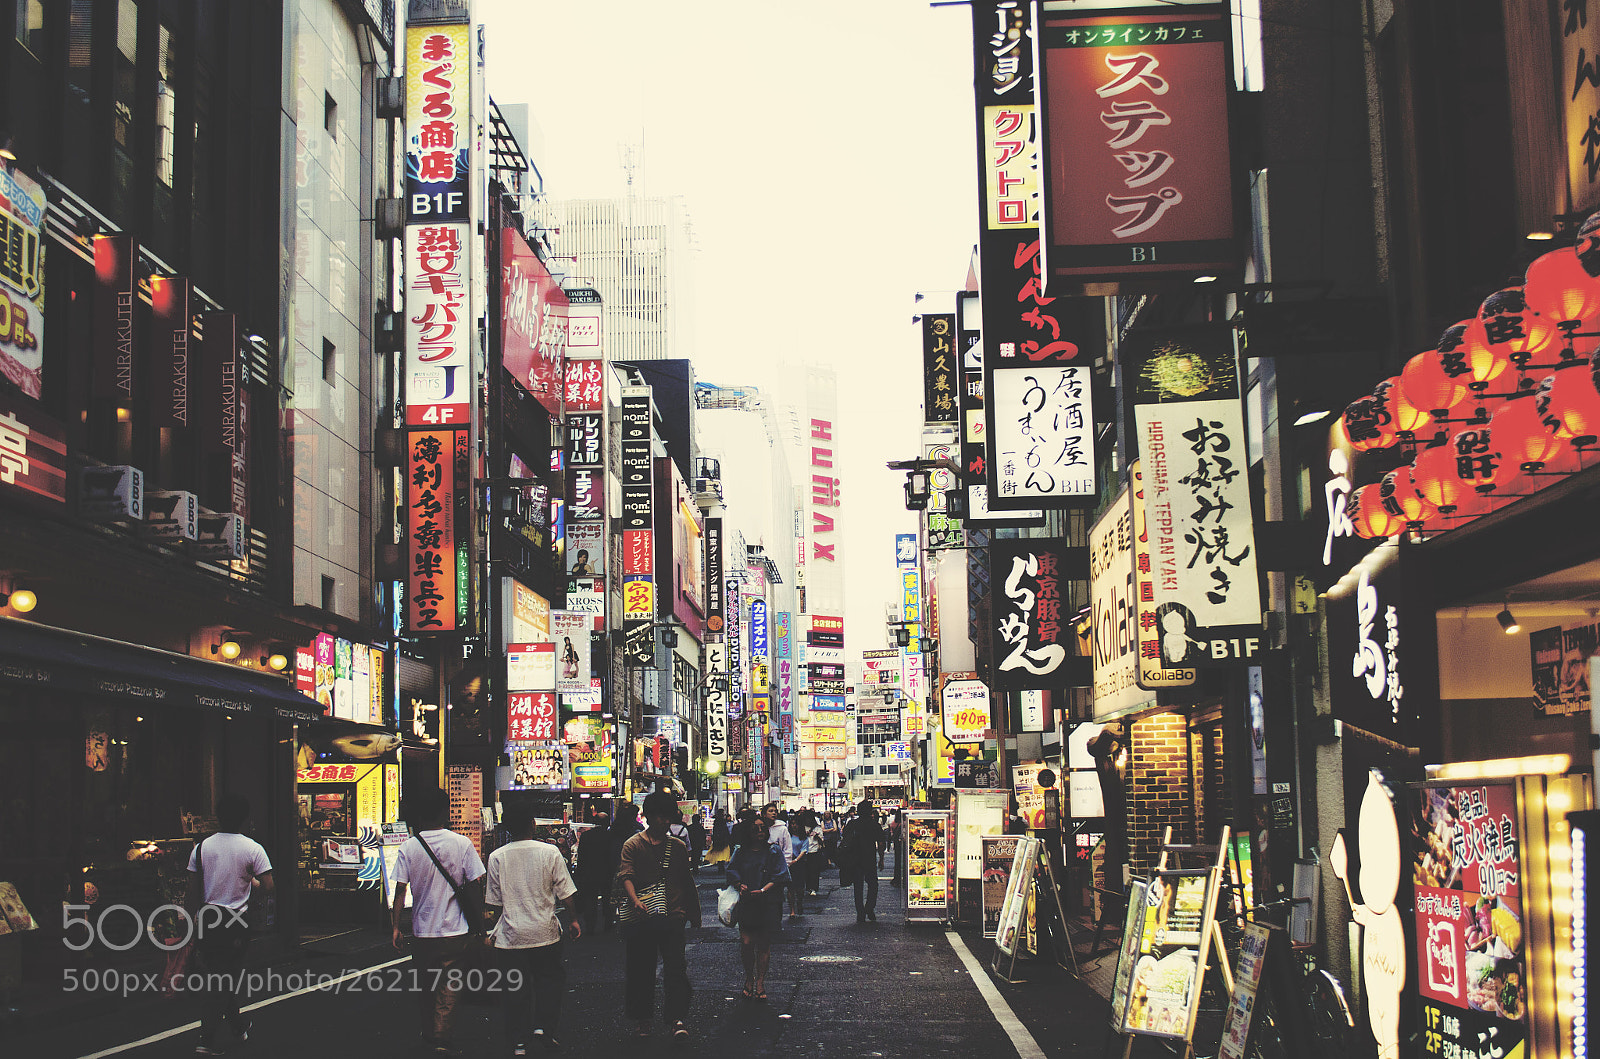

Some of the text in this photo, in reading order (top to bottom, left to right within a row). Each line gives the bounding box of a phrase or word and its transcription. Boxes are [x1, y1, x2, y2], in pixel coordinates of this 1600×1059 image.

[1065, 26, 1205, 45] オンラインカフェ
[420, 34, 456, 183] まぐろ商店
[992, 110, 1027, 225] クアトロ
[1094, 51, 1183, 240] ステップ
[411, 191, 464, 216] B1F
[1130, 245, 1157, 263] B1
[411, 226, 465, 364] 熟女キャバクラ
[116, 291, 132, 391] ANRAKUTEI
[172, 329, 187, 423] ANRAKUTEI
[413, 377, 441, 392] mrs
[427, 365, 465, 401] J
[932, 336, 953, 412] 山久農場
[221, 361, 235, 449] ANRAKUTEI
[421, 405, 455, 425] 4F
[1052, 366, 1088, 467] 居酒屋
[570, 428, 584, 463] ルーム
[585, 416, 600, 463] レンタル
[1017, 375, 1056, 493] うまいもん
[131, 470, 141, 517] BBQ
[575, 470, 592, 506] エデン
[810, 417, 841, 562] HUMAX
[1001, 450, 1018, 496] 一番街
[1061, 478, 1093, 494] B1F
[186, 495, 196, 537] BBQ
[1147, 420, 1178, 591] HIROSHIMA TEPPANYAKI
[1178, 417, 1250, 605] お好み焼き
[234, 516, 244, 558] BBQ
[632, 531, 643, 574] リフレッシュ
[568, 597, 604, 606] XROSS
[1035, 551, 1061, 643] 東京豚骨
[753, 602, 766, 647] カラオケ
[1209, 636, 1260, 660] B1F
[780, 660, 791, 711] カラオケ
[1142, 669, 1195, 681] KollaBo
[510, 693, 554, 718] 湖南
[1458, 785, 1489, 823] 絶品!
[1451, 813, 1517, 869] 炭火焼鳥
[1424, 1005, 1441, 1030] 1F
[1425, 1030, 1442, 1054] 2F
